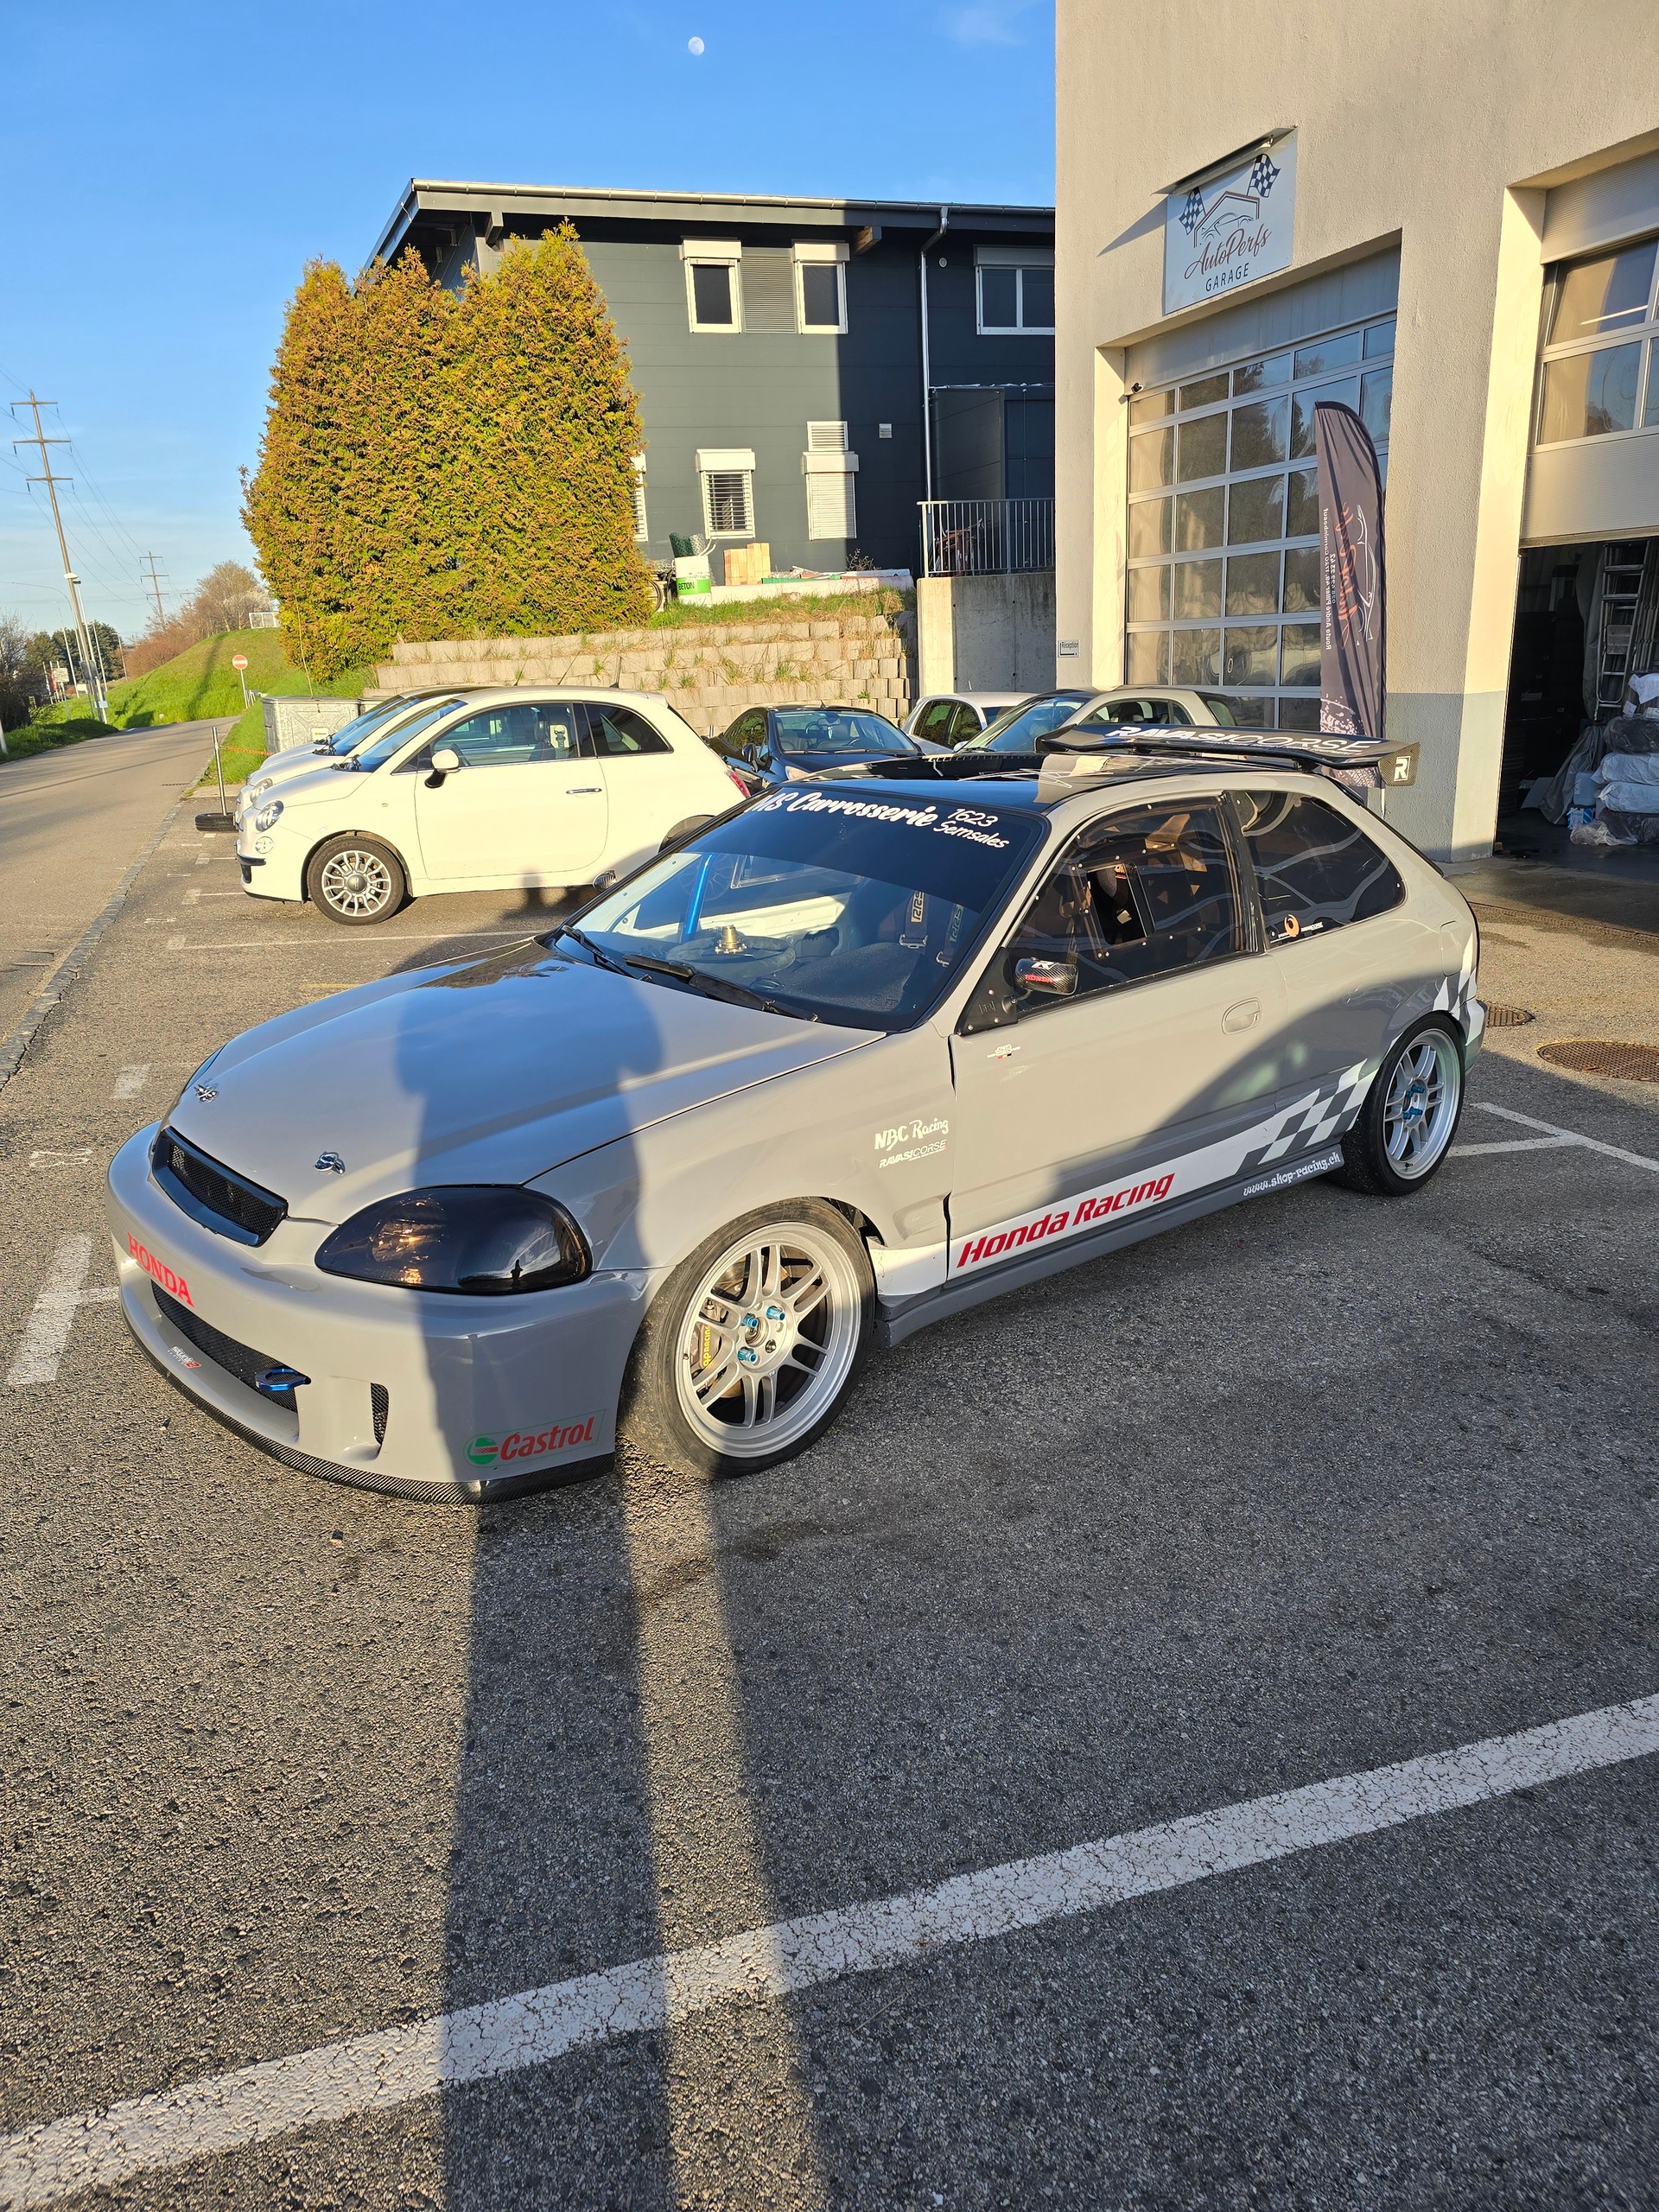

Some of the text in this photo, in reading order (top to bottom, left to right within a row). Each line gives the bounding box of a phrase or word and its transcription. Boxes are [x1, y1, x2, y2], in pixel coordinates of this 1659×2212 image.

[1184, 223, 1273, 279] AutoPerfs
[1205, 263, 1249, 292] GARAGE
[678, 582, 695, 590] BETON
[1394, 757, 1409, 781] R
[786, 791, 938, 828] Carrosserie
[946, 808, 999, 828] 1623
[932, 820, 1010, 849] Semsales
[1025, 974, 1053, 983] HONDA
[874, 1117, 949, 1151] NBC Racing
[1243, 1151, 1341, 1197] www.shop-racing.ch
[957, 1173, 1175, 1268] Honda Racing
[127, 1232, 194, 1307] HONDA
[500, 1416, 594, 1461] Castrol
